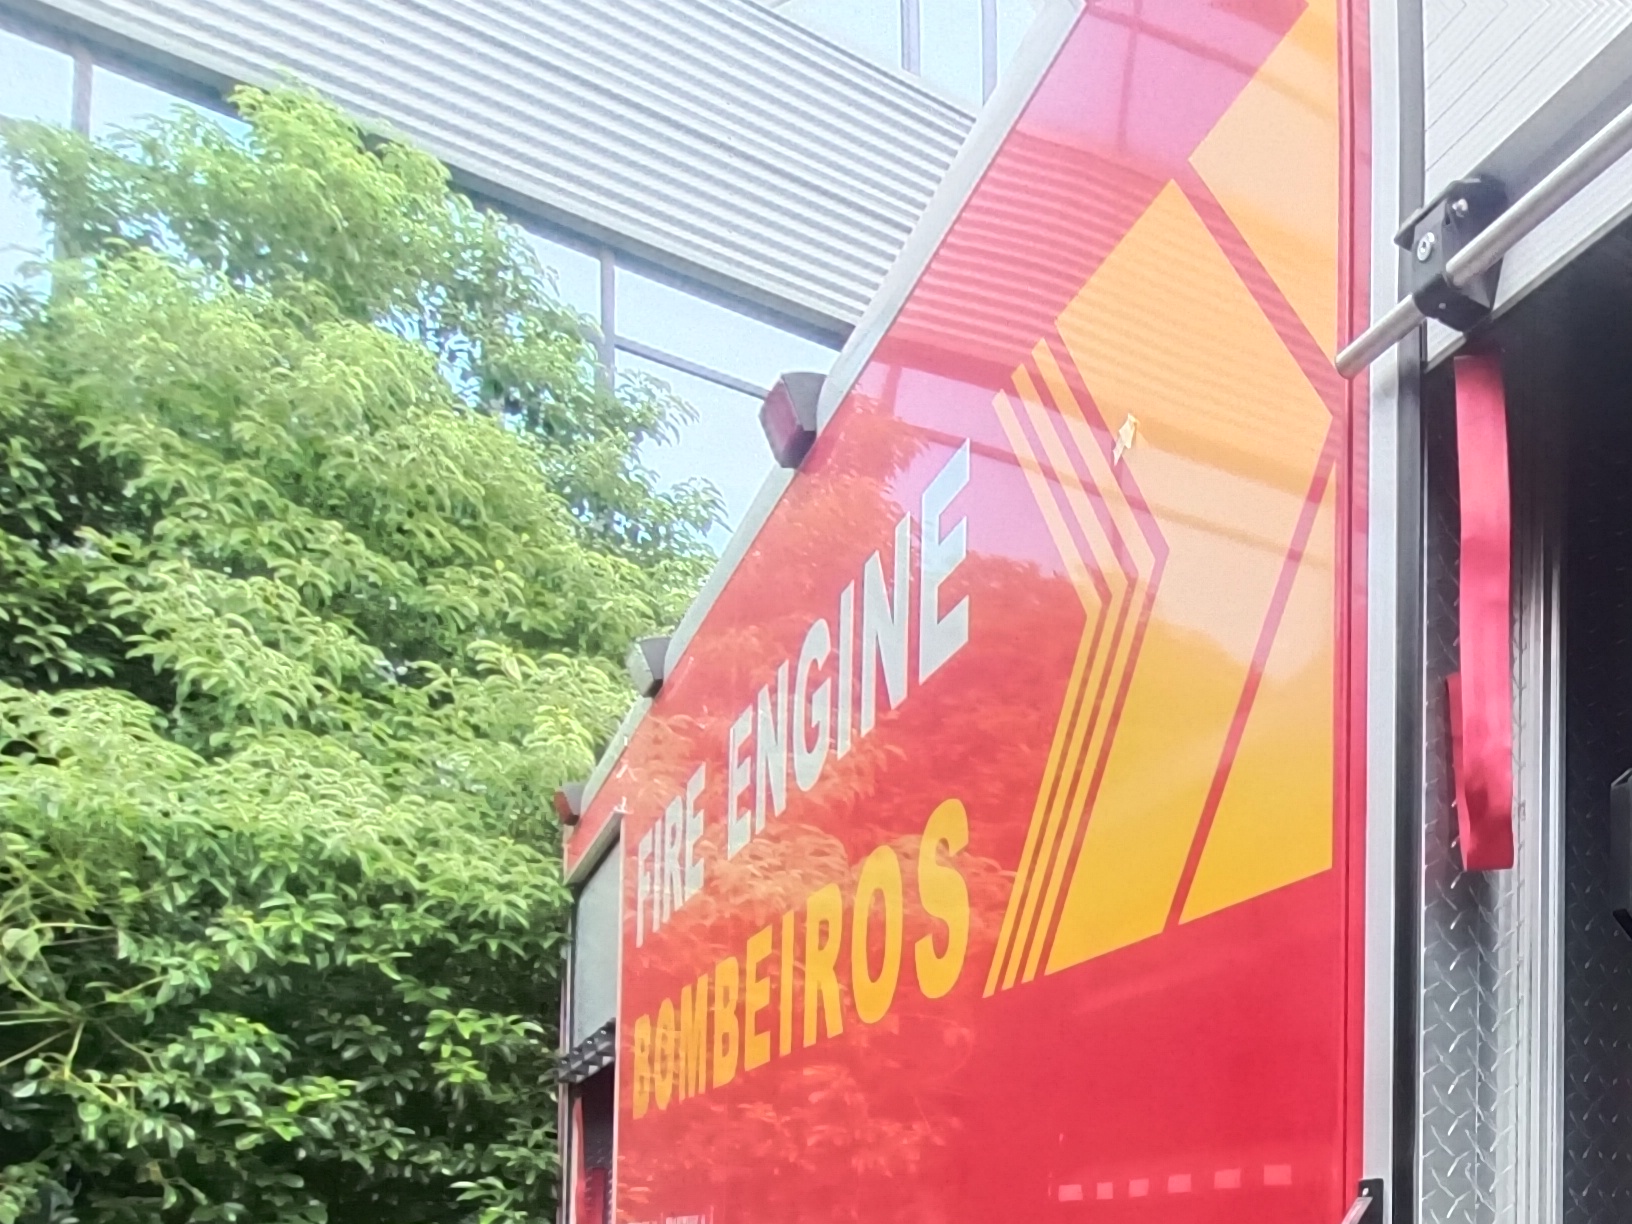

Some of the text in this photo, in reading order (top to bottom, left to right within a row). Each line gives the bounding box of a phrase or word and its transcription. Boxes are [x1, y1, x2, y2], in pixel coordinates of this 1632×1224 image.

[635, 437, 970, 948] FIRE ENGINE
[632, 798, 970, 1120] BOMBEIROS
